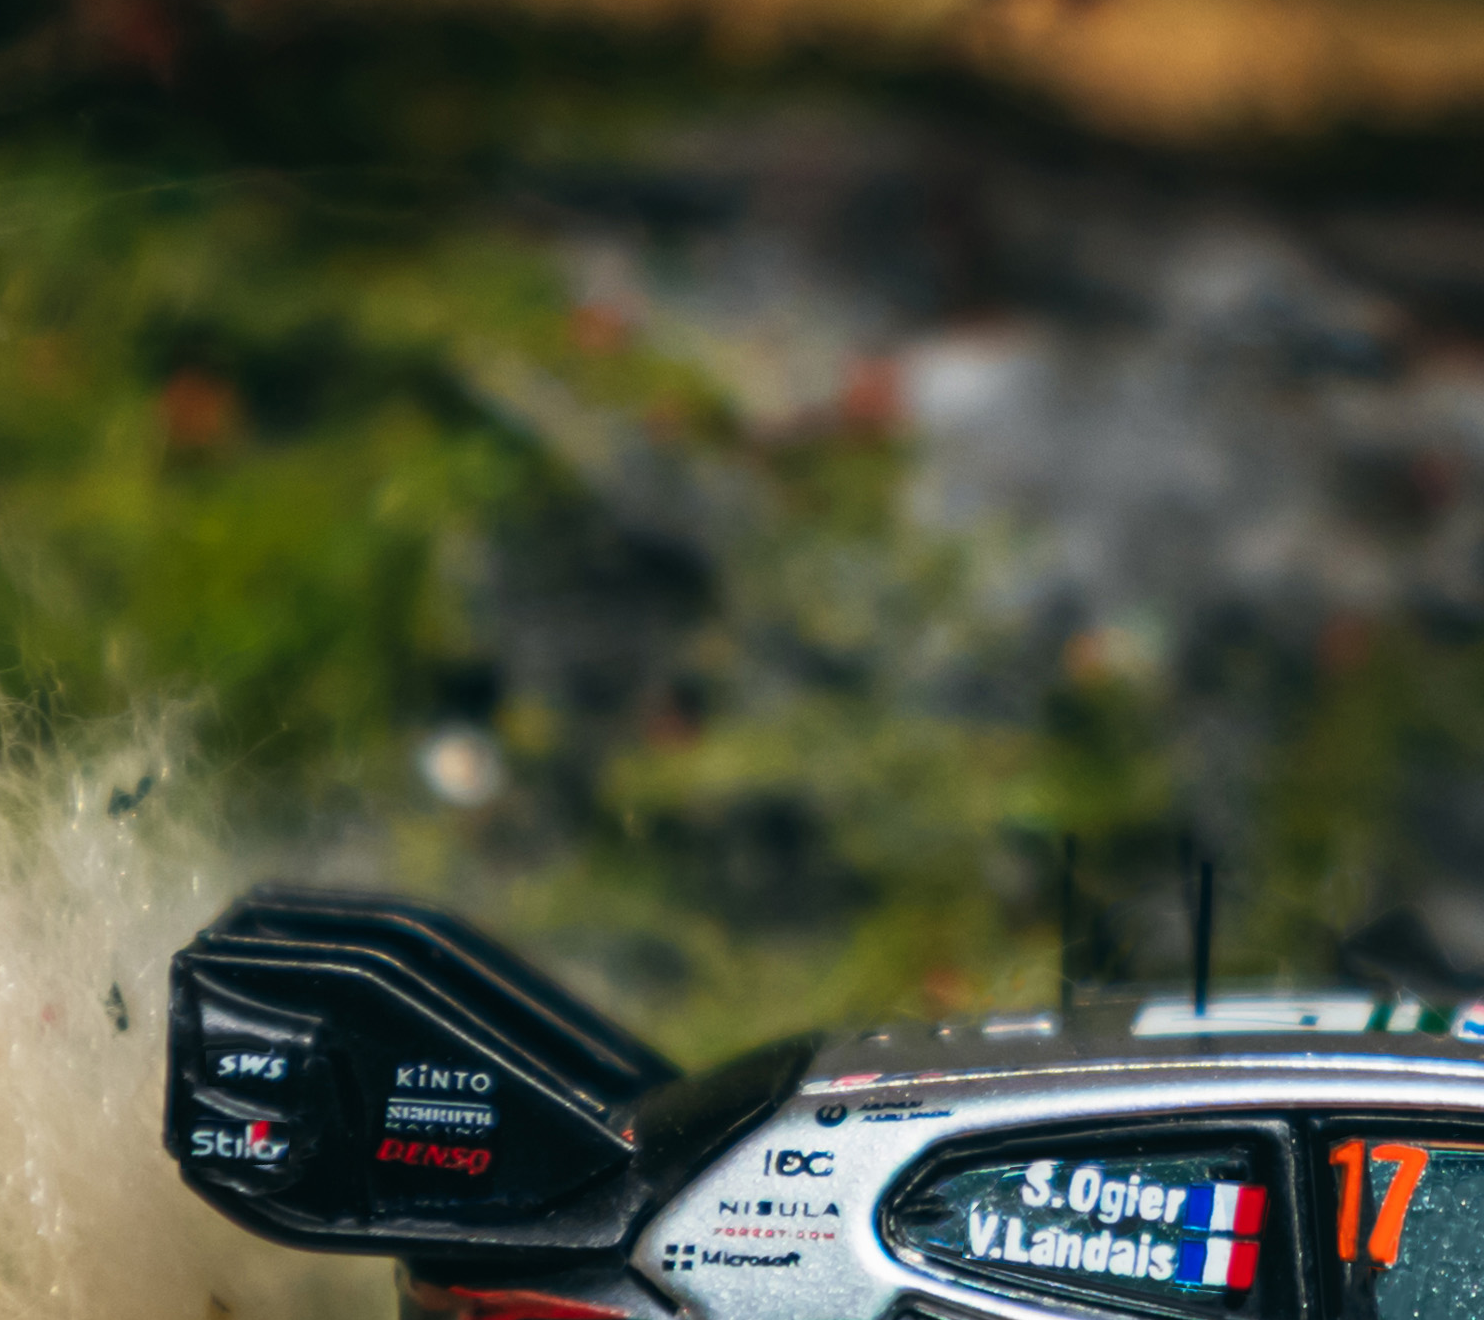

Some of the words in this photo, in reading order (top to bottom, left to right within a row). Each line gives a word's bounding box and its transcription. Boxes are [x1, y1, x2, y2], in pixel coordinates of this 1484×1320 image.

[968, 1200, 1177, 1281] V.Landais
[1329, 1138, 1428, 1269] 17
[701, 1249, 801, 1268] Microsoft
